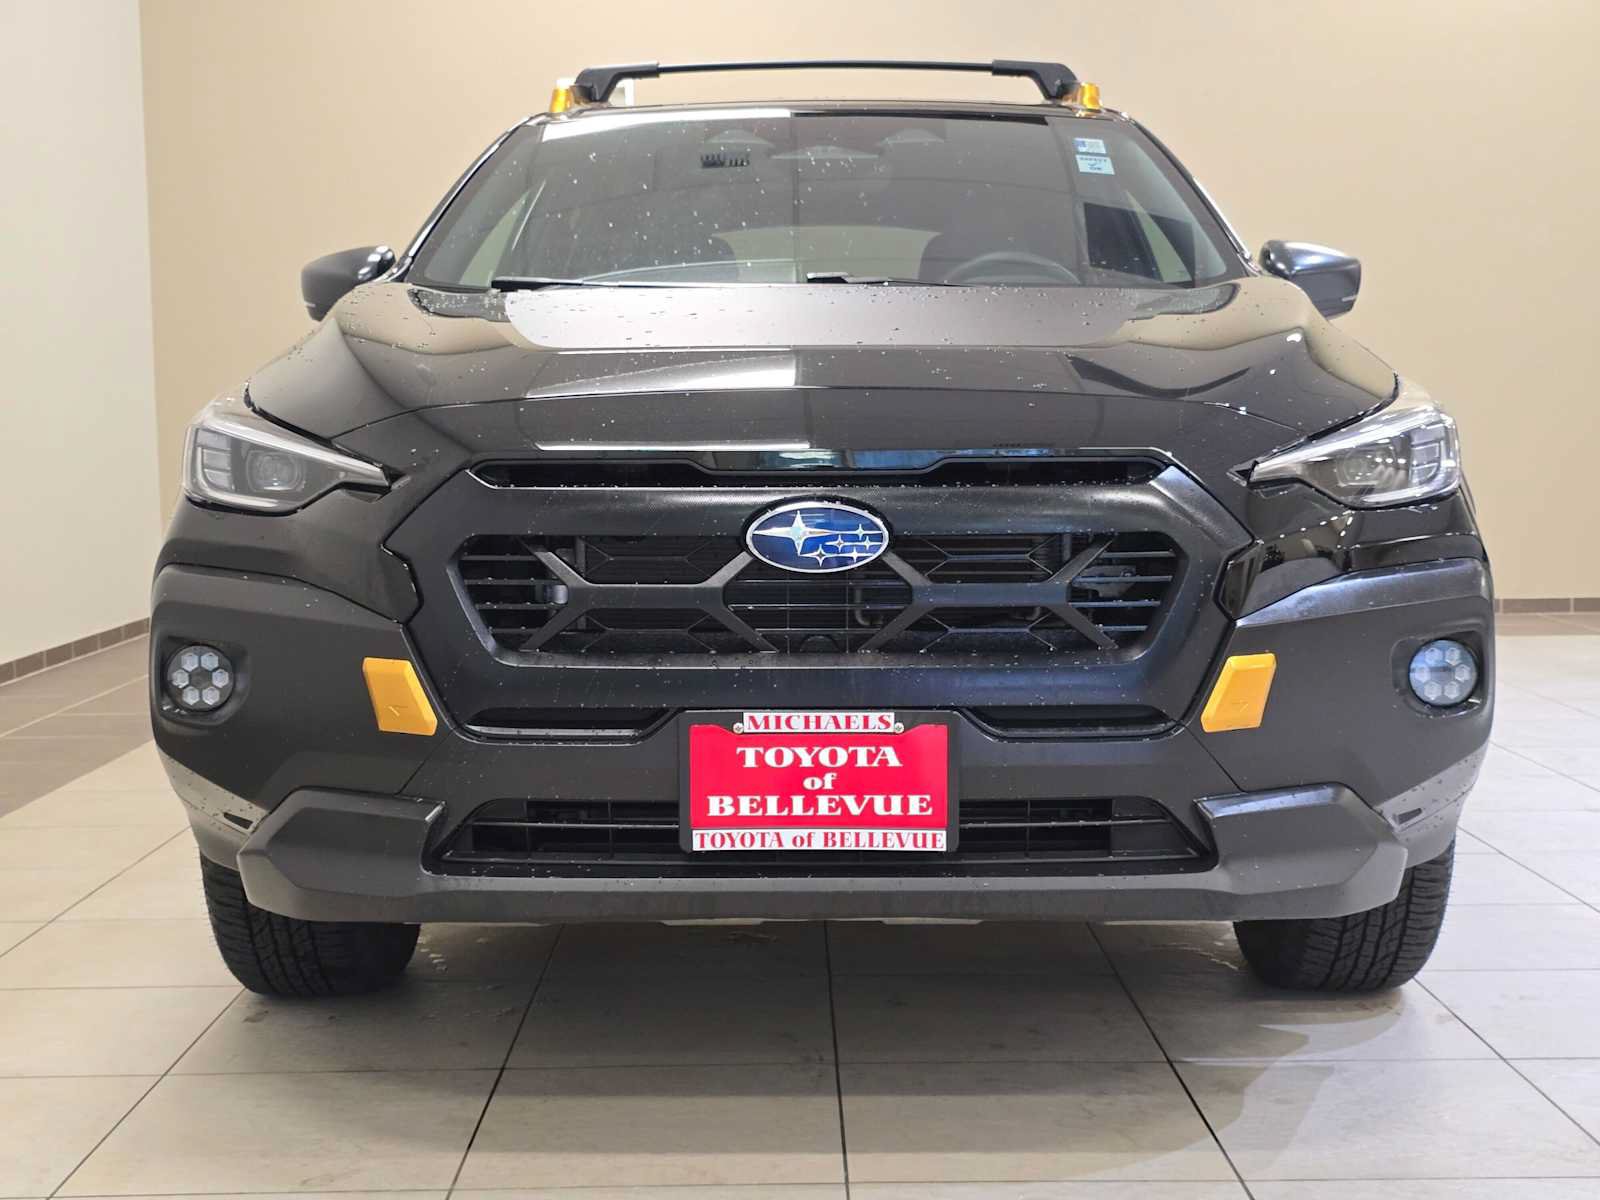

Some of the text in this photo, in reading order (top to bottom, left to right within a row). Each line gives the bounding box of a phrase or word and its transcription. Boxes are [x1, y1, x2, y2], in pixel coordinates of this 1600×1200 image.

[747, 714, 892, 730] MICHAELS
[736, 746, 903, 768] TOYOTA
[802, 771, 837, 791] of
[707, 795, 932, 816] BELLEVUE
[695, 831, 944, 849] TOYOTA of BELLEVUE
